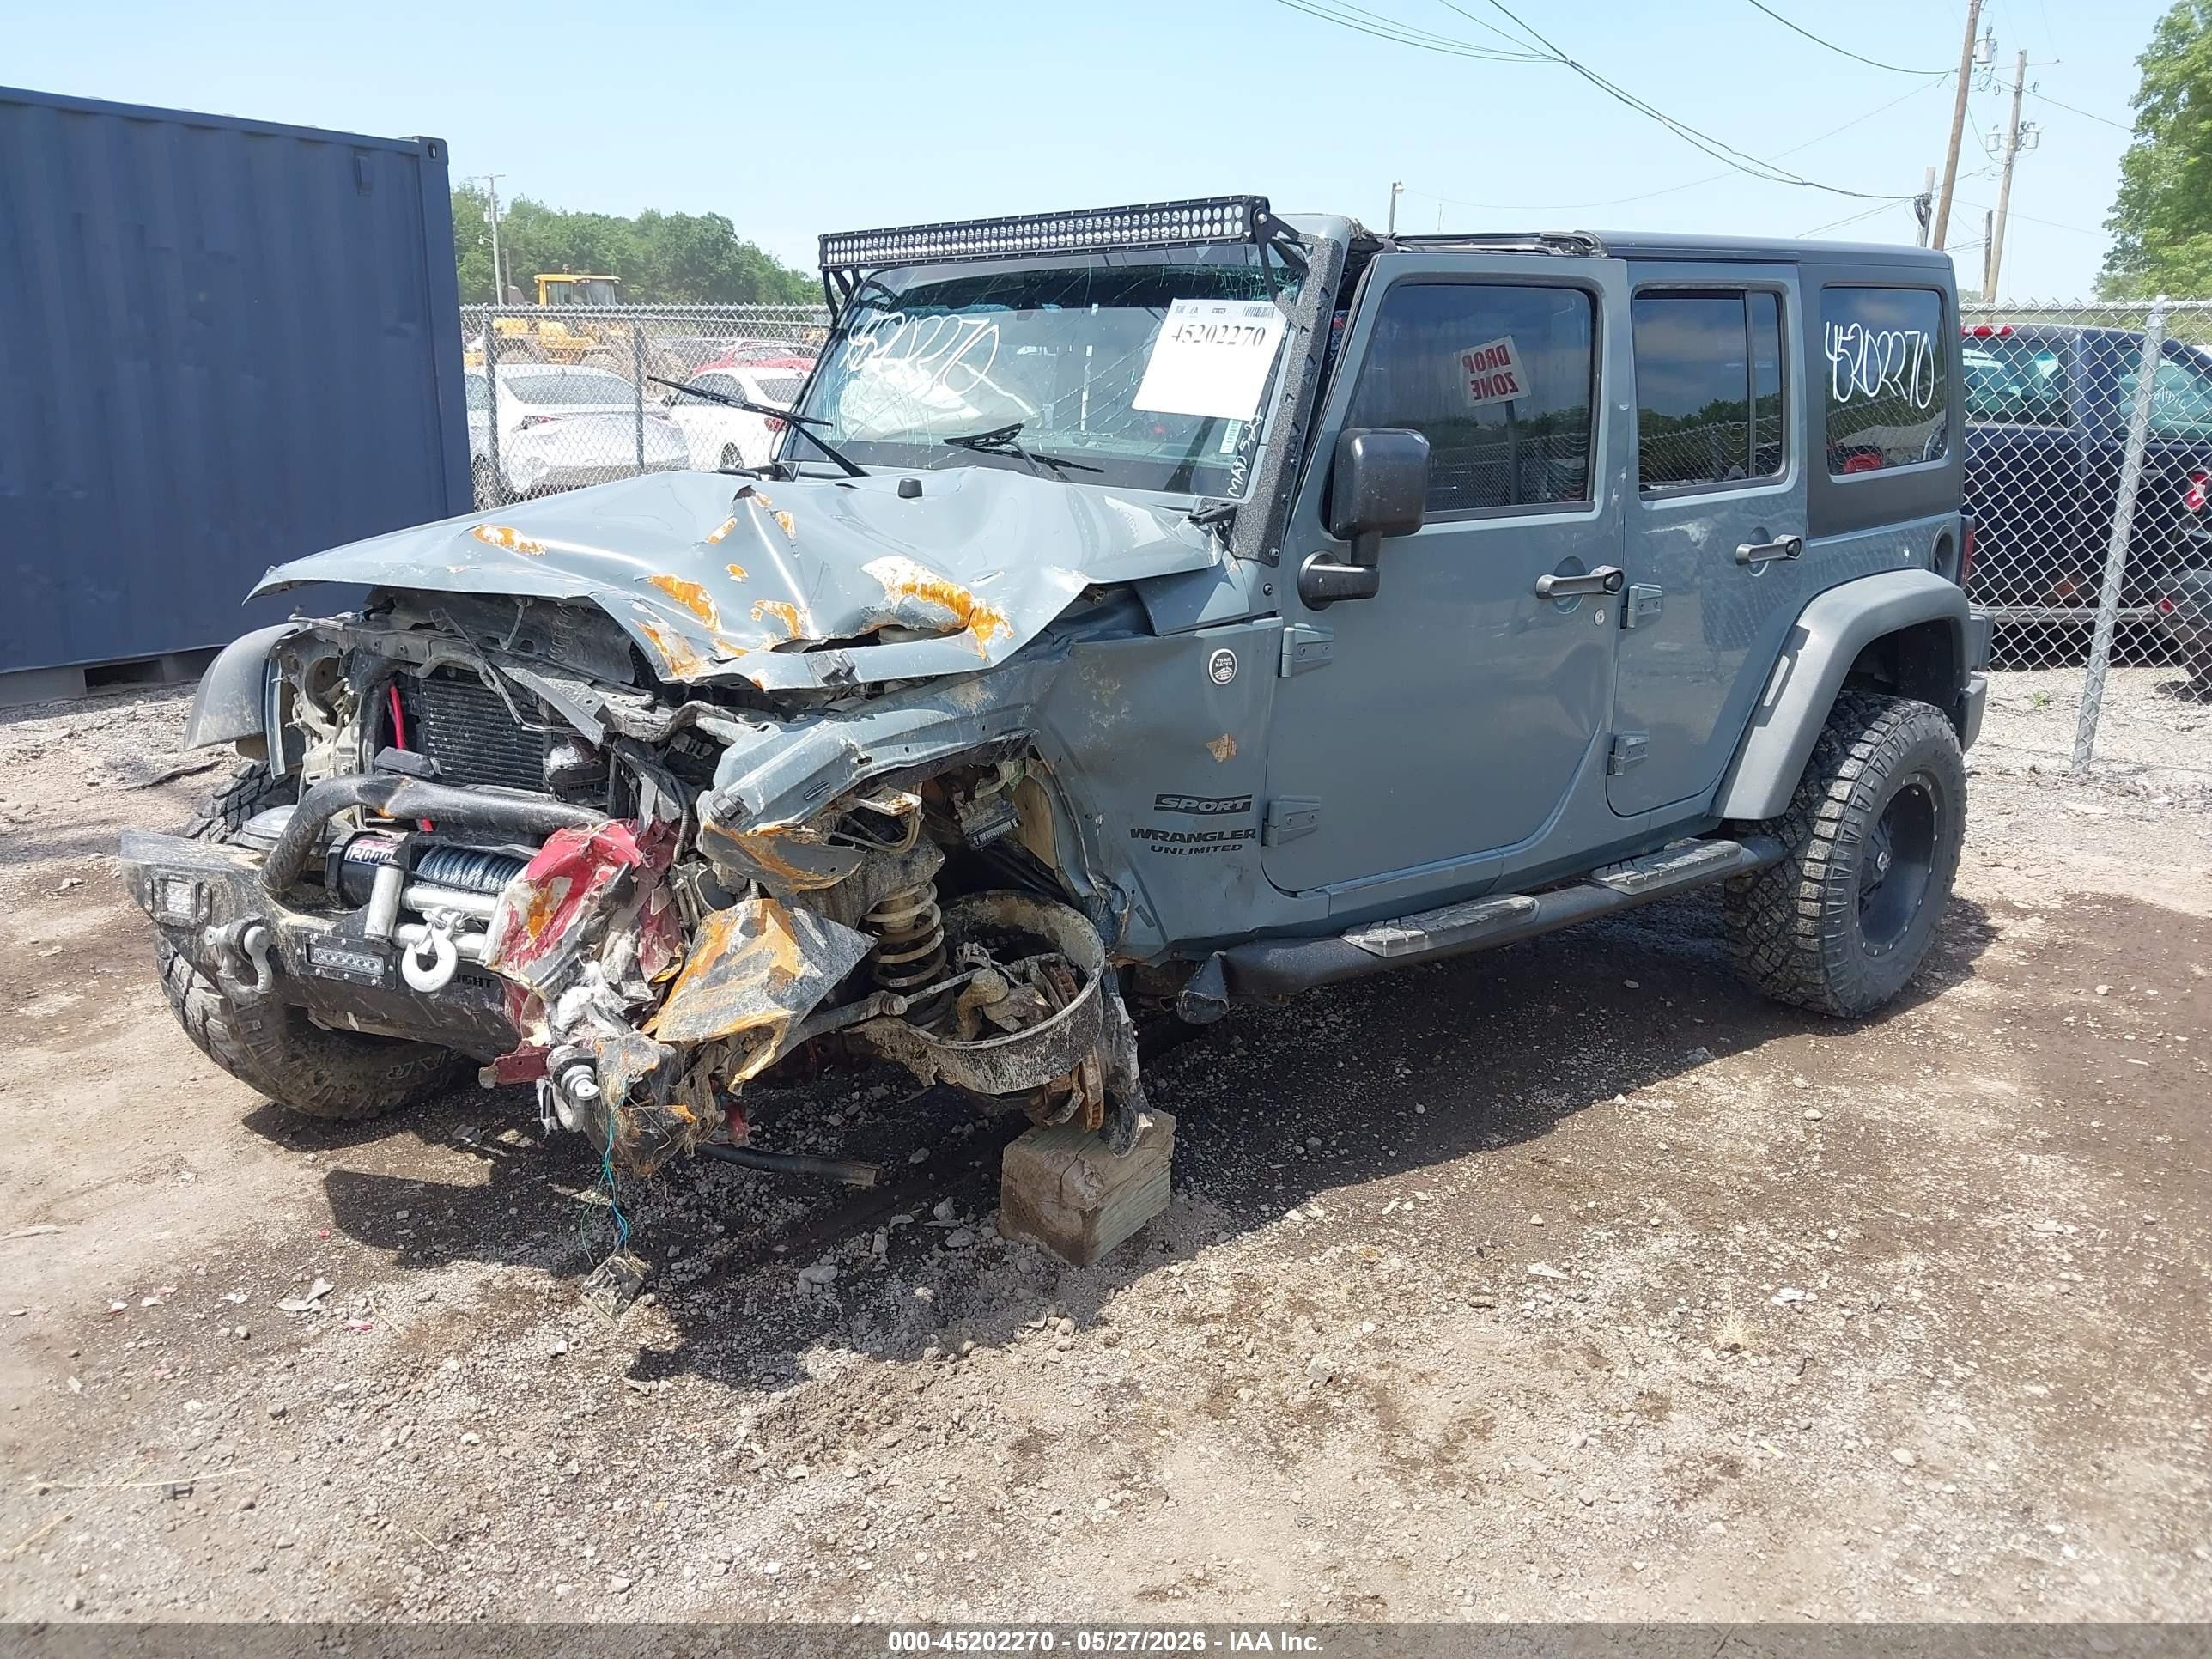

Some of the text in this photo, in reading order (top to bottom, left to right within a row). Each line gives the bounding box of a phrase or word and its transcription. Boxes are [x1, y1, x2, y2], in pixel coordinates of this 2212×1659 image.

[1172, 324, 1267, 346] 45202270
[1825, 321, 1935, 409] 45202270
[1227, 455, 1248, 498] MAD
[1155, 797, 1252, 812] SPORT
[1130, 828, 1256, 843] WRANGLER
[1150, 844, 1243, 855] UNLIMITED
